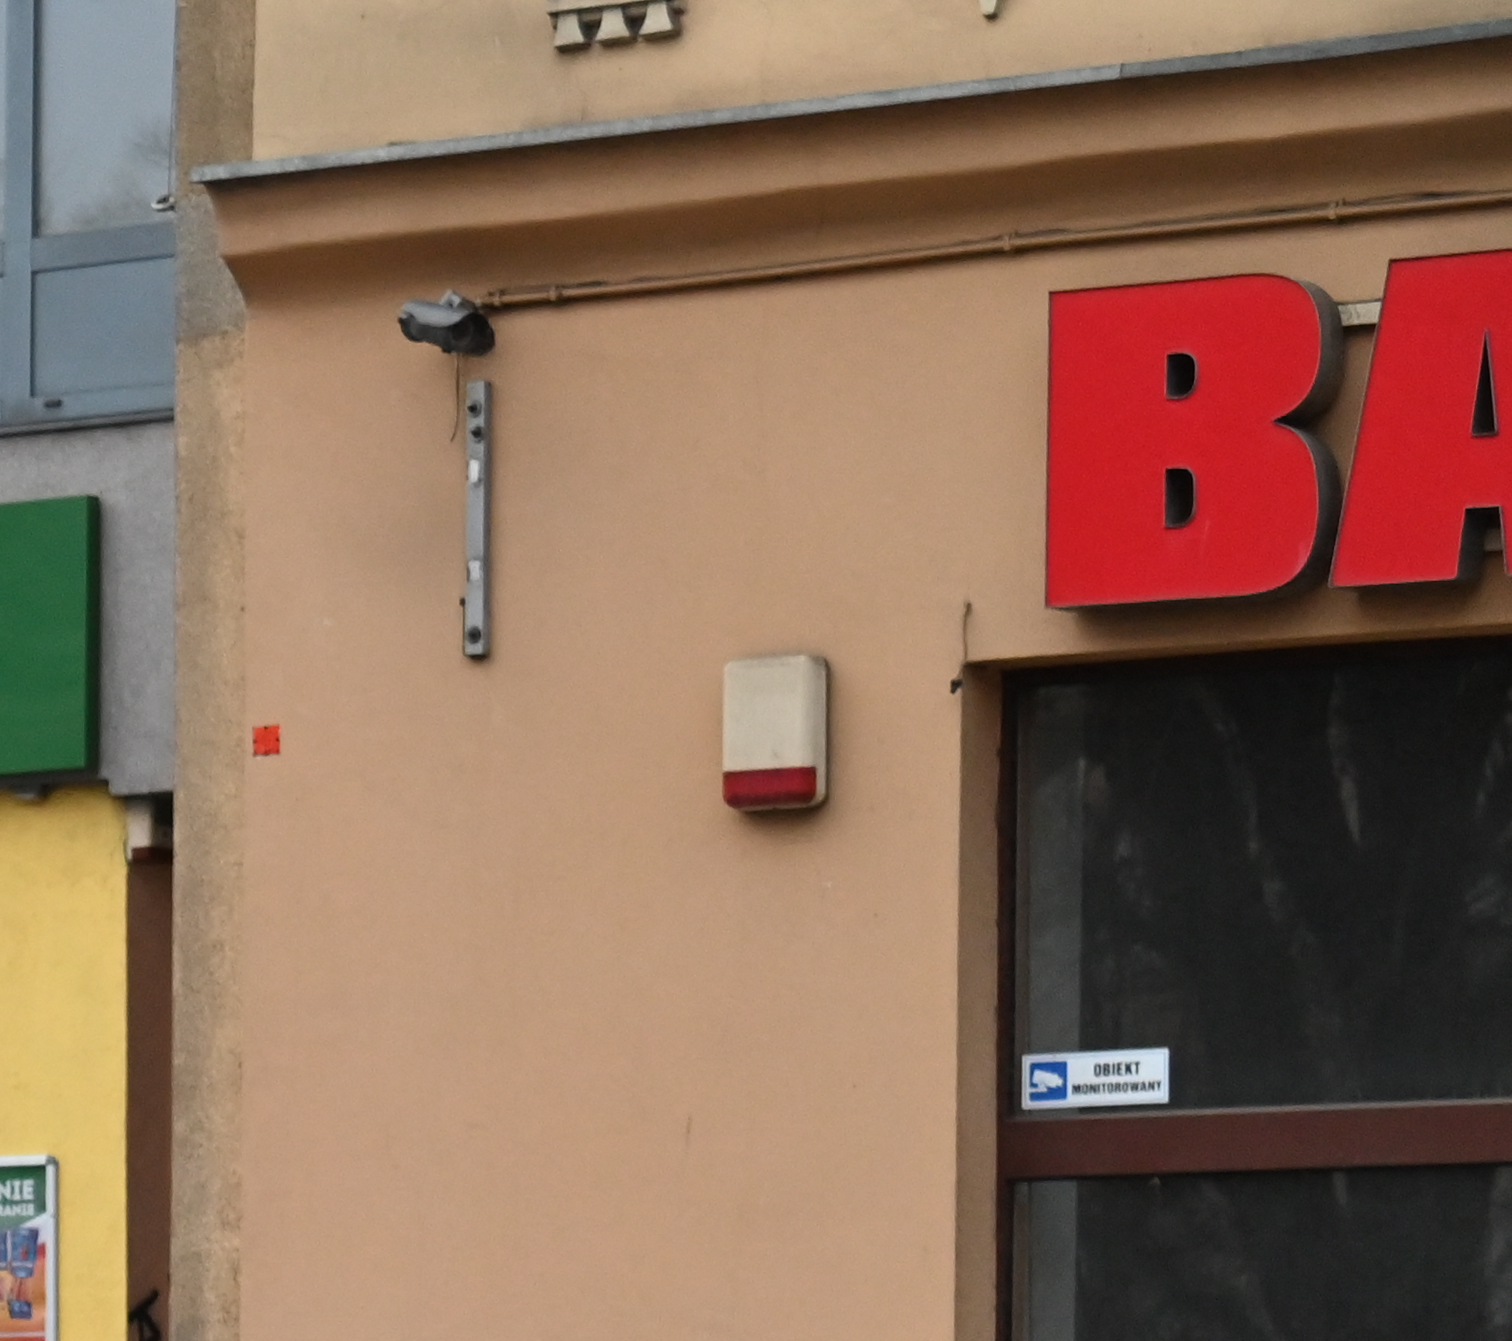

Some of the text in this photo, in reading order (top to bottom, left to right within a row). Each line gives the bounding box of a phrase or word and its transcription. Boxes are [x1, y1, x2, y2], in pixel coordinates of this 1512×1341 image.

[1045, 248, 1512, 612] BA
[1093, 1061, 1141, 1077] OBIEKT
[1071, 1080, 1162, 1095] MONITOROWANY
